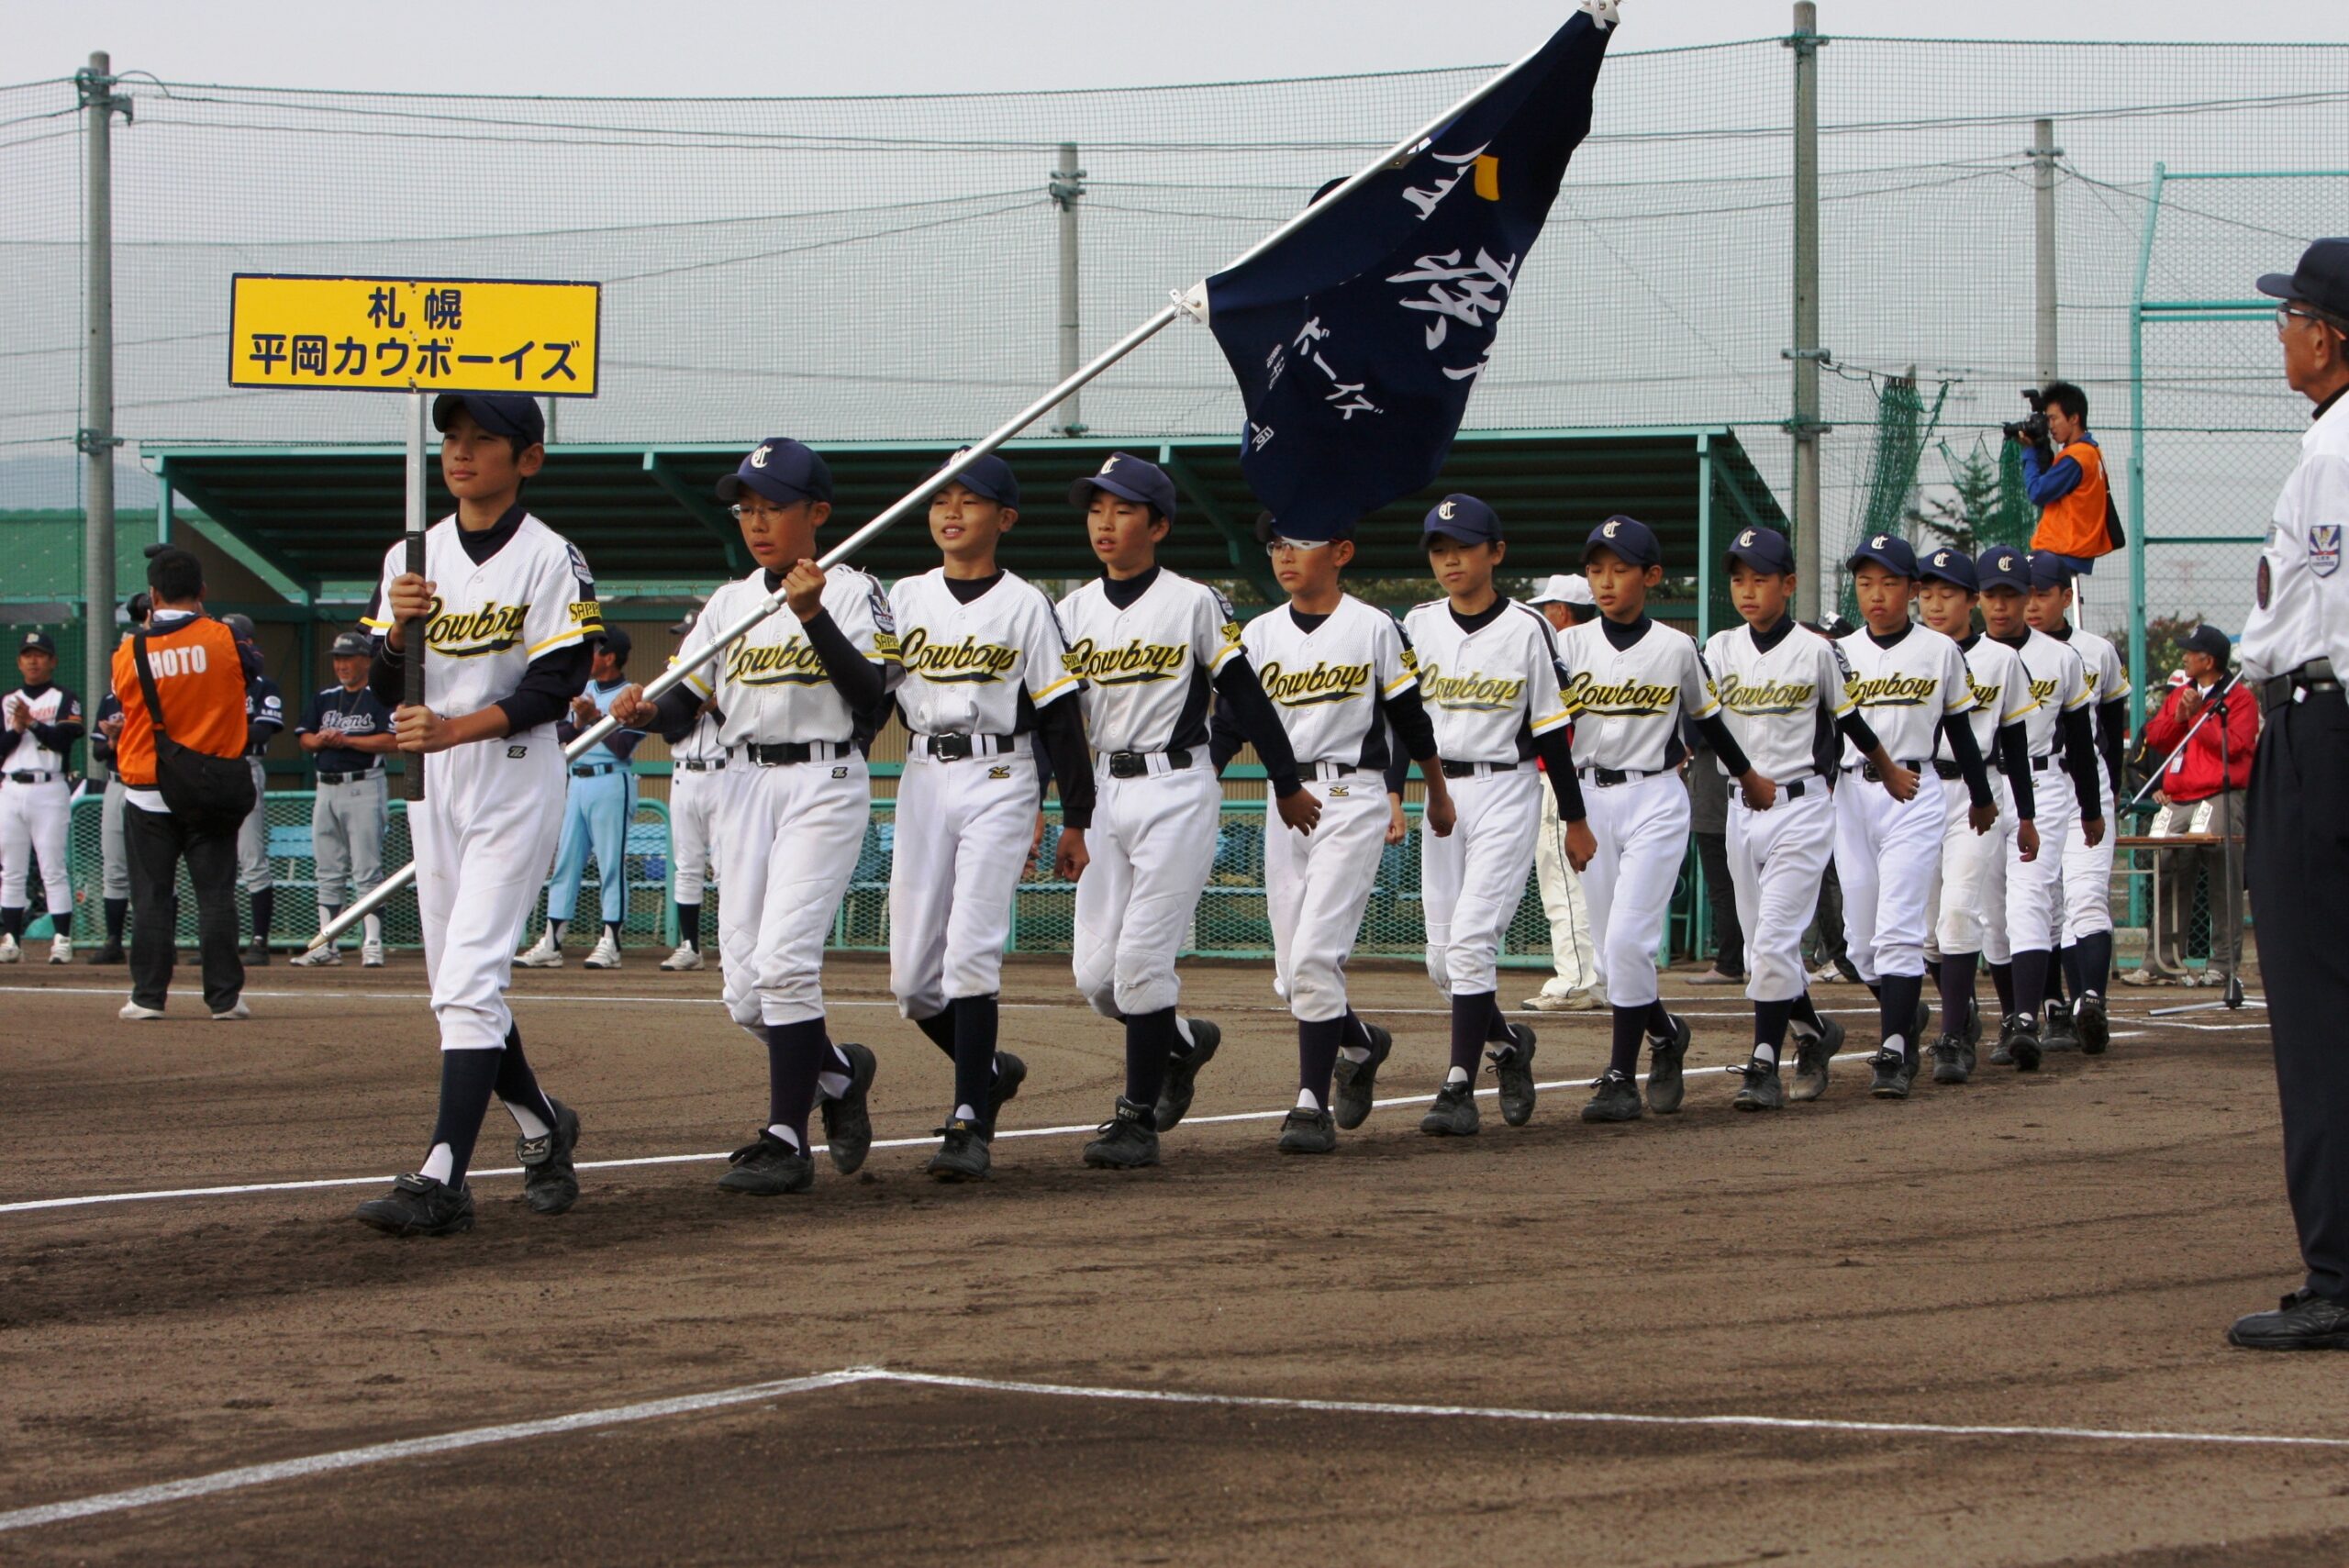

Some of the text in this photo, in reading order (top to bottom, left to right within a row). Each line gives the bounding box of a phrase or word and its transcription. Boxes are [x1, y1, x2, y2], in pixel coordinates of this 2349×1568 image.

[367, 286, 462, 330] 札幌
[249, 332, 581, 382] 平岡カウボーイズ
[134, 645, 207, 679] HOTO
[725, 634, 829, 677] Cowbo
[899, 627, 1020, 677] Cowboys
[1074, 638, 1189, 677] Cowboys
[1259, 661, 1373, 700] Cowboys
[1419, 662, 1527, 703] Cowboys
[1570, 671, 1679, 707] Cowboys
[1719, 673, 1816, 708] Cowboys
